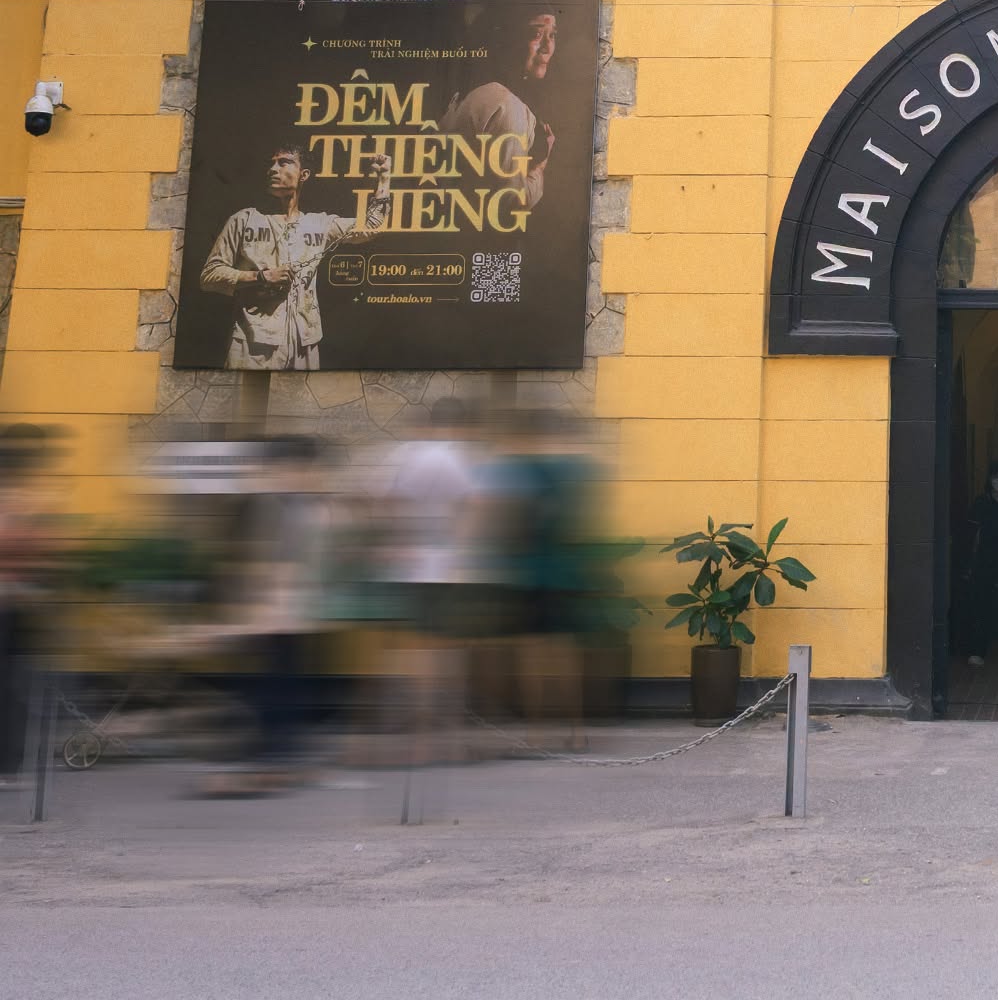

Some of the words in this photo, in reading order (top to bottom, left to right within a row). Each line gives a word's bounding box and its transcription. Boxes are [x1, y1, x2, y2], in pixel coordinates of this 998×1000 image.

[322, 39, 366, 48] CHƯƠNG
[368, 37, 402, 48] TRÌNH
[370, 48, 395, 59] TRẢI
[397, 48, 439, 60] NGHIỆM
[441, 46, 468, 58] BUỔI
[469, 46, 488, 58] TỐI
[294, 68, 430, 126] ĐÊM
[309, 120, 533, 178] THIÊNG
[350, 175, 532, 232] LIÊNG
[371, 264, 407, 276] 19:00
[426, 264, 463, 276] 21:00
[367, 294, 433, 303] tour.hoalo.vn
